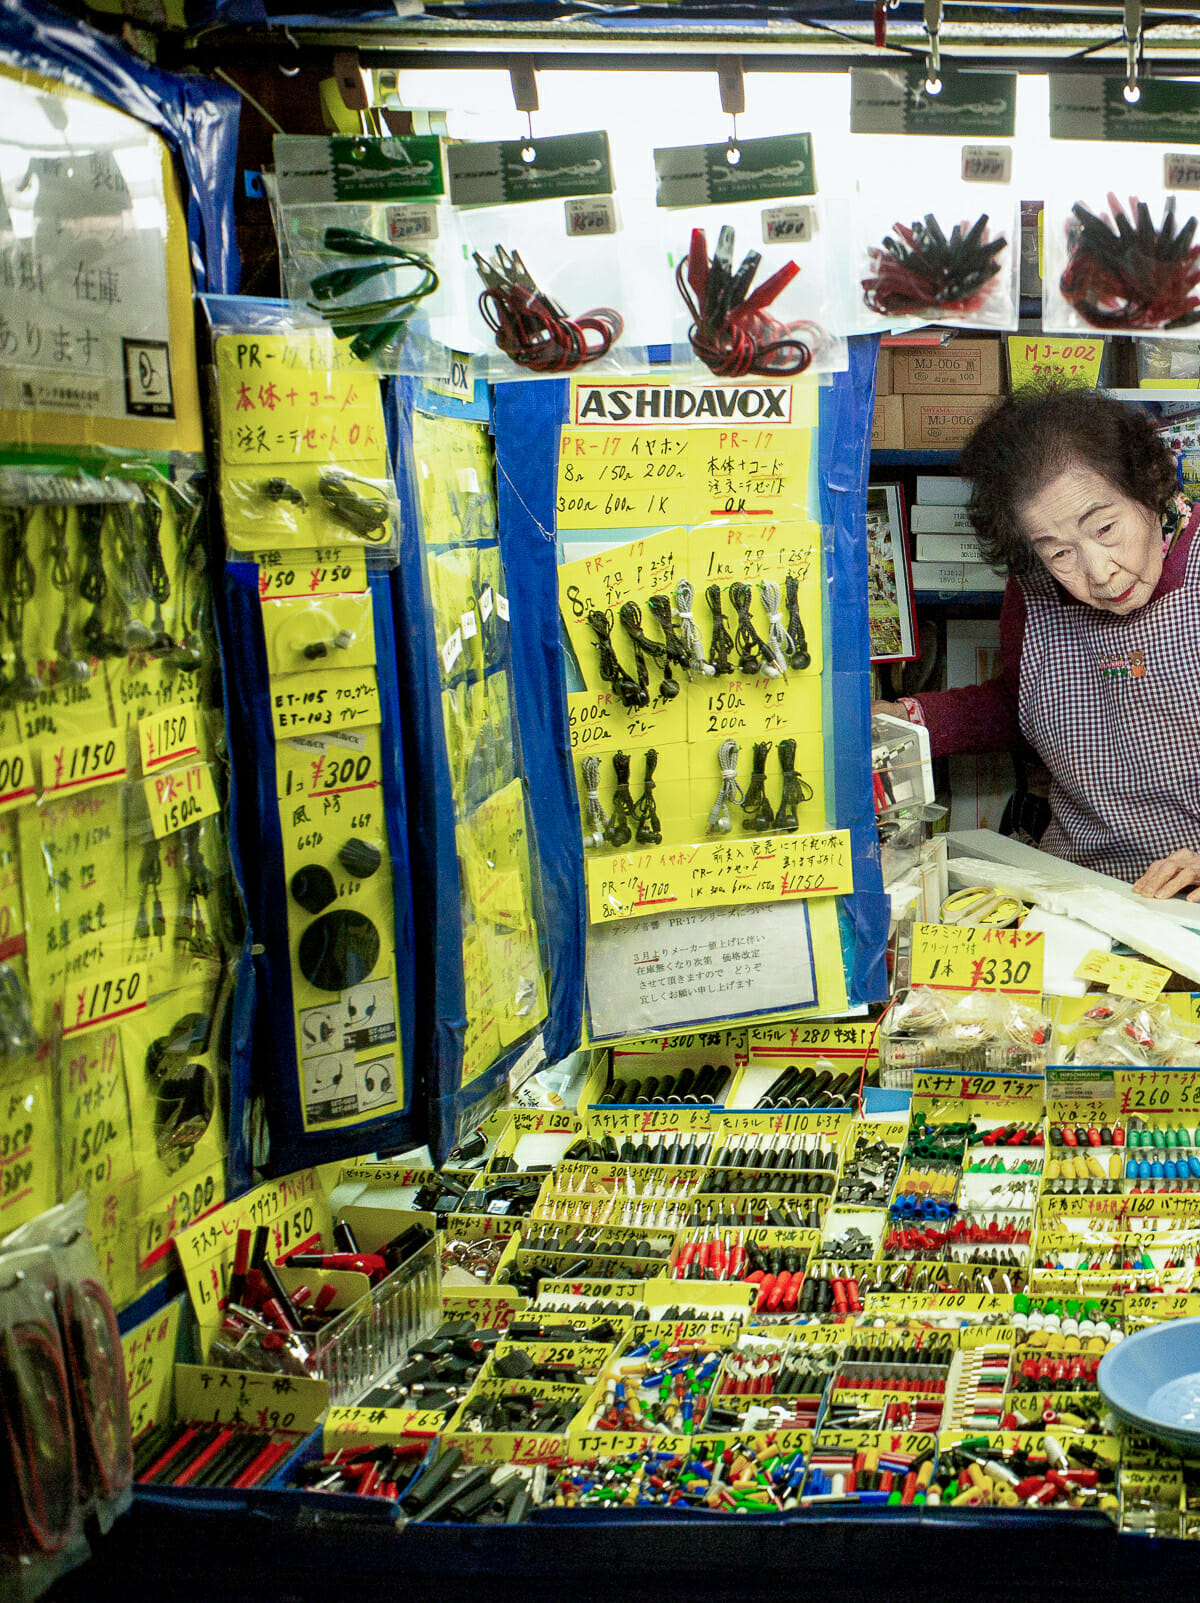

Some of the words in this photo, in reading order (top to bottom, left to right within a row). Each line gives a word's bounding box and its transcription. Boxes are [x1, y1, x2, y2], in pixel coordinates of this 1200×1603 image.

[1025, 344, 1096, 362] MJ-002
[914, 358, 961, 370] MJ-006
[959, 373, 974, 381] 100
[580, 388, 786, 420] ASHIDAVOX
[928, 415, 974, 426] MJ-006
[562, 436, 621, 456] PR-17
[631, 437, 690, 455] イヤホン
[718, 432, 773, 449] PR-17
[724, 497, 746, 511] OK
[275, 690, 328, 707] ET-105
[278, 710, 332, 726] ET-103
[146, 716, 187, 755] ¥1750
[53, 740, 115, 786] ¥1750
[311, 755, 371, 788] ¥300
[780, 871, 825, 895] ¥1750
[983, 930, 1043, 947] イヤホン
[637, 955, 713, 975] 在庫無くなり次第
[722, 949, 761, 963] 価格改定
[639, 969, 724, 990] させて頂きますので
[735, 963, 762, 974] どうぞ
[971, 957, 1031, 987] ¥330
[76, 972, 141, 1025] ¥1750
[639, 978, 754, 1004] 宜しくお願い申し上げます
[662, 1035, 695, 1051] ¥300
[790, 1028, 830, 1045] ¥280
[916, 1077, 957, 1093] バナナ
[960, 1077, 995, 1096] ¥90
[1120, 1087, 1170, 1113] ¥260
[642, 1112, 679, 1130] ¥130
[775, 1114, 808, 1130] ¥110
[1120, 1197, 1158, 1220] ¥160
[571, 1283, 612, 1297] ¥200
[928, 1294, 965, 1310] ¥100
[673, 1322, 706, 1339] ¥130
[1011, 1395, 1038, 1411] RCA
[513, 1436, 560, 1460] ¥200
[578, 1436, 635, 1451] TJ-1-J
[640, 1435, 684, 1451] ¥65
[766, 1433, 807, 1448] ¥65
[819, 1433, 882, 1449] TJ-2J
[890, 1434, 933, 1452] ¥70
